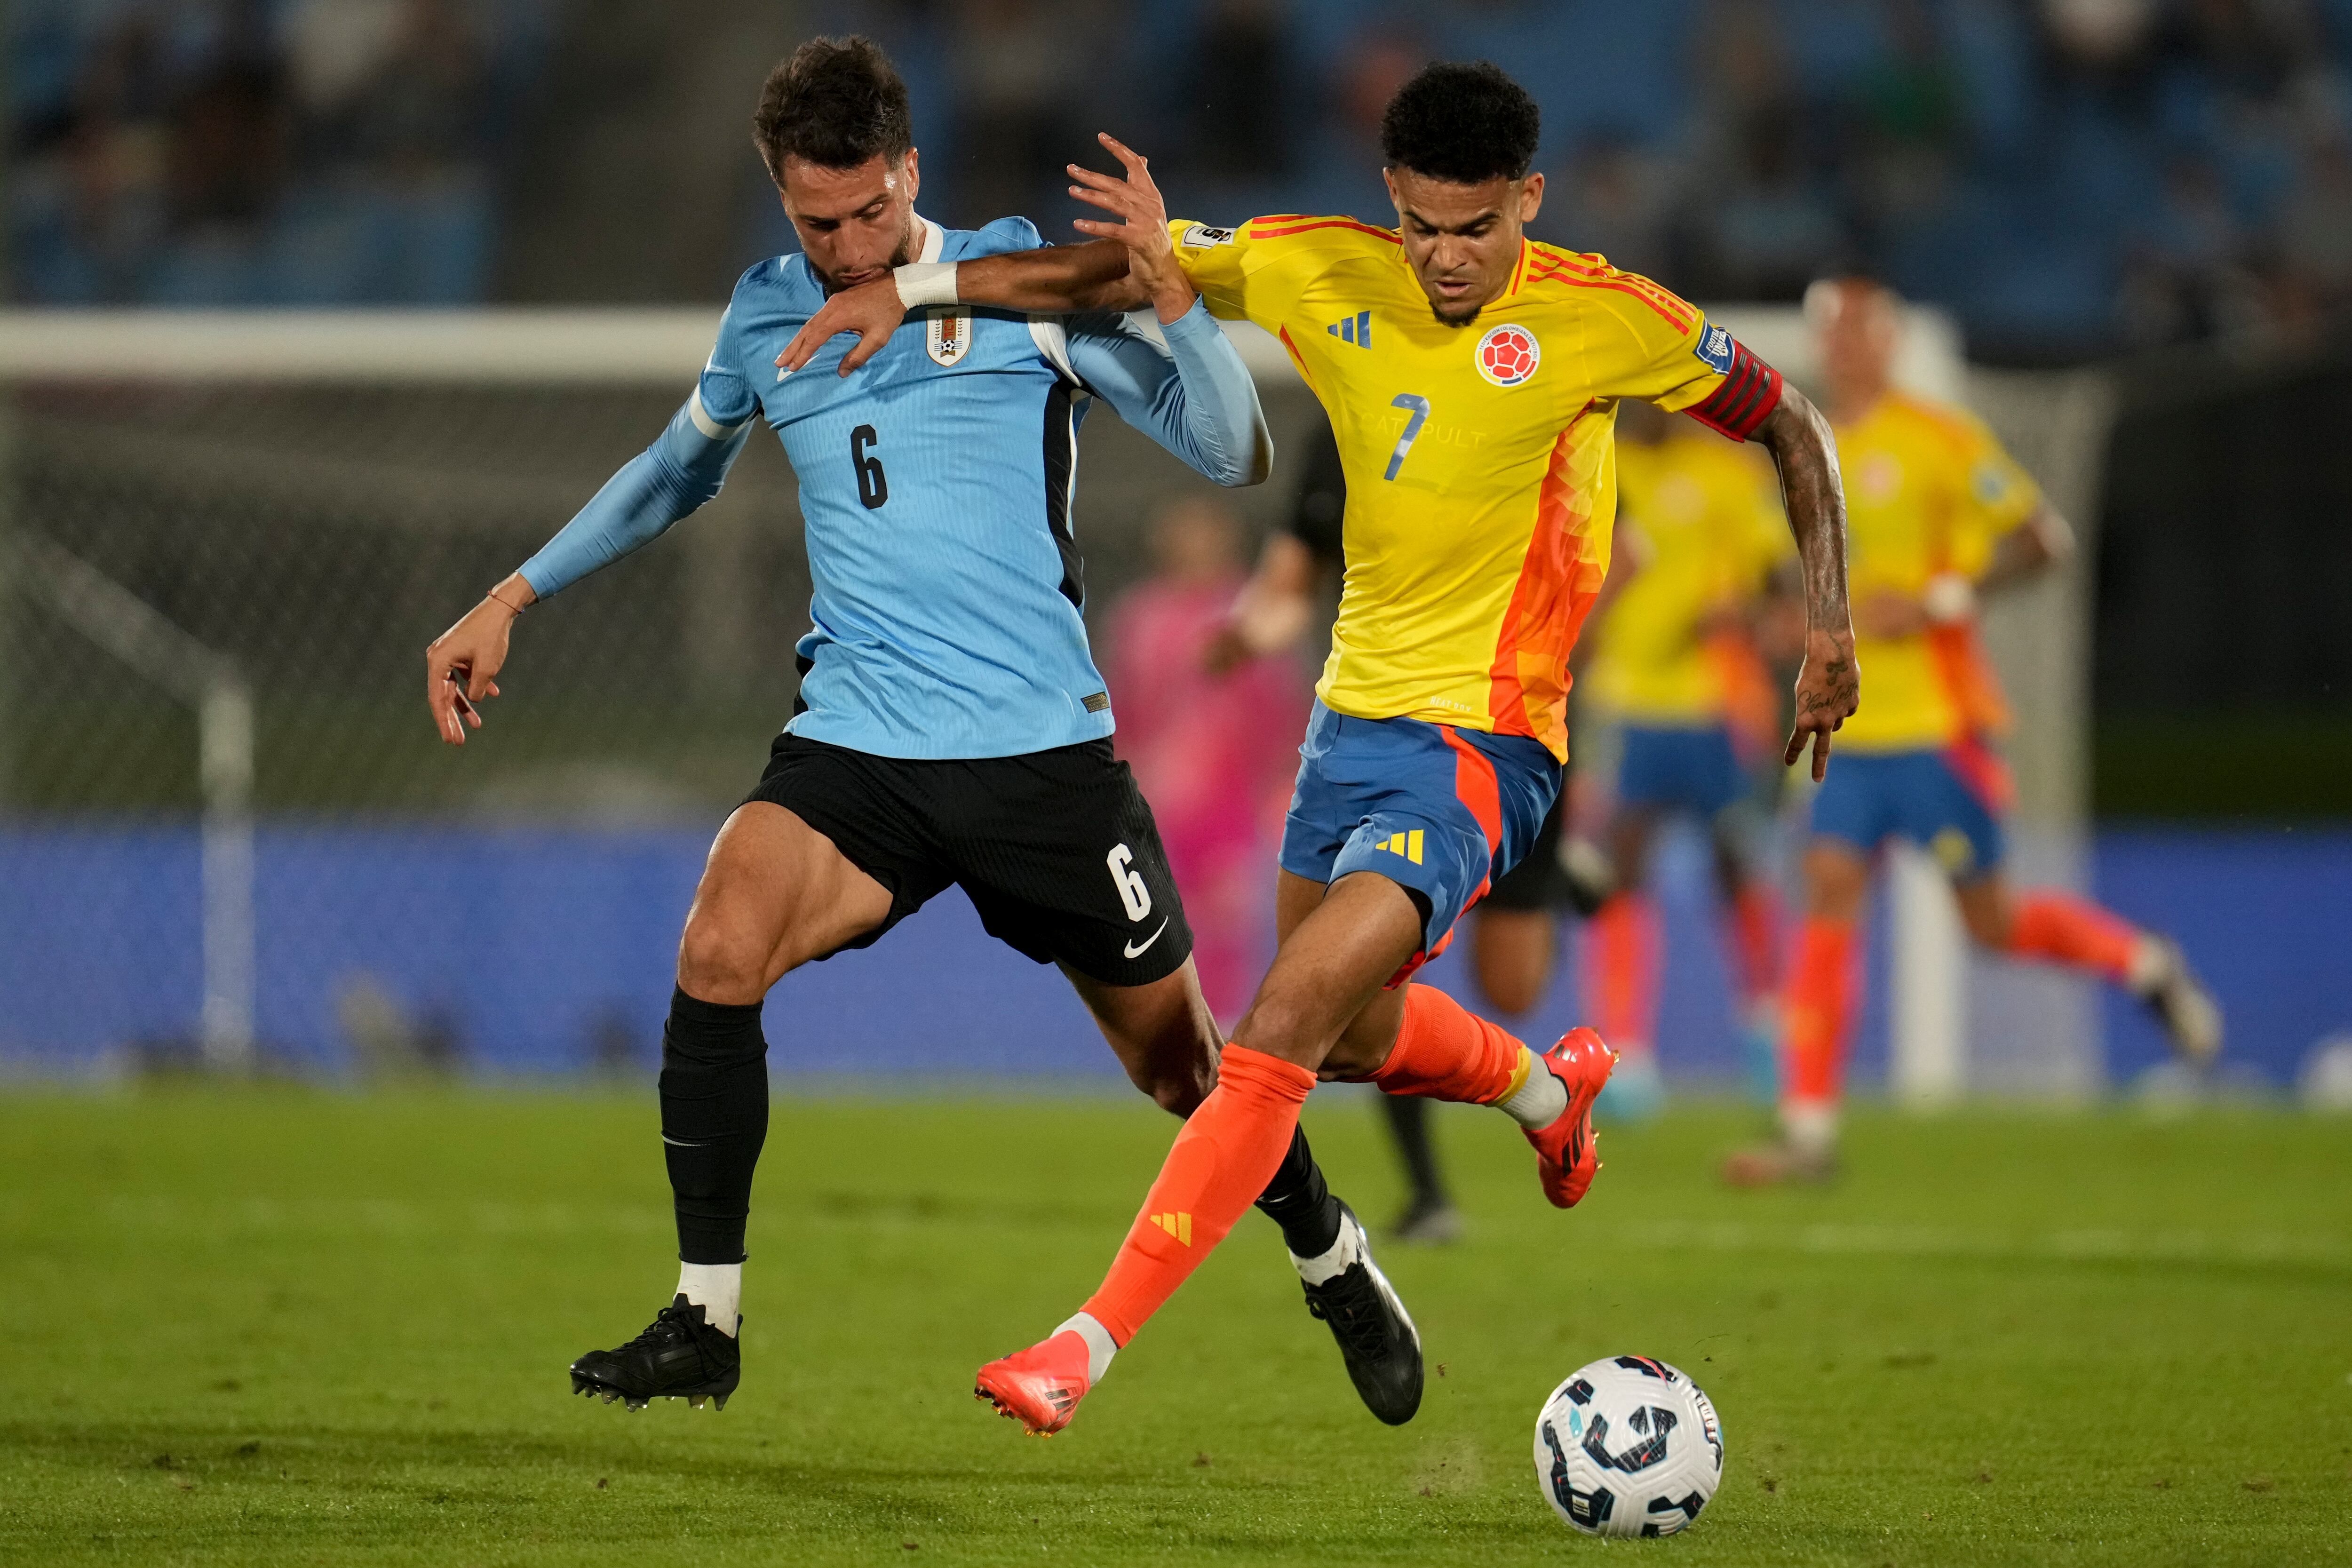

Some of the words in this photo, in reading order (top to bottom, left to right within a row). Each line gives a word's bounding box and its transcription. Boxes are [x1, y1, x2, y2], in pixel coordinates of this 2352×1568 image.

[1501, 326, 1528, 337] COLOMBIANA
[1706, 328, 1720, 351] FOOTBA
[1361, 413, 1487, 450] CATPULT
[1384, 393, 1430, 481] 7
[850, 424, 888, 510] 6
[1106, 843, 1152, 922] 6
